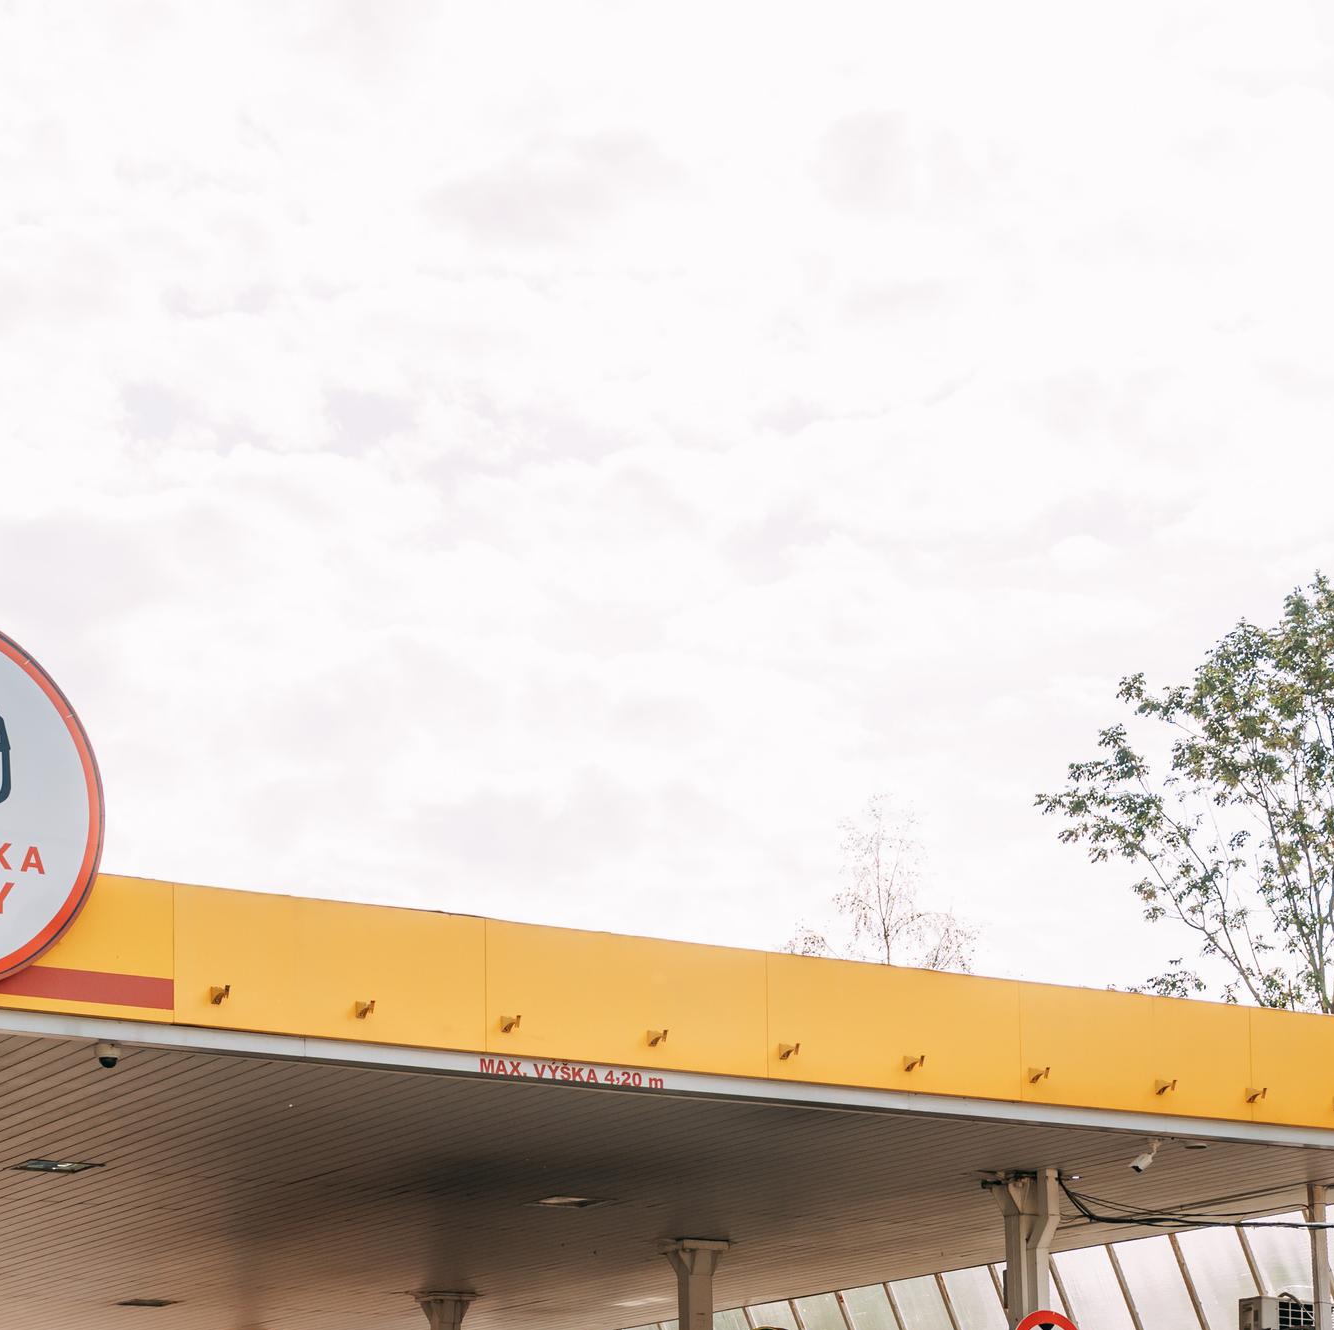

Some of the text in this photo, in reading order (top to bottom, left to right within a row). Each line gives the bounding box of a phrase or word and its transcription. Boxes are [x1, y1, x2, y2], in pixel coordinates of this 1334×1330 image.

[479, 1058, 664, 1089] MAX. VÝŠKA 4,20 m
